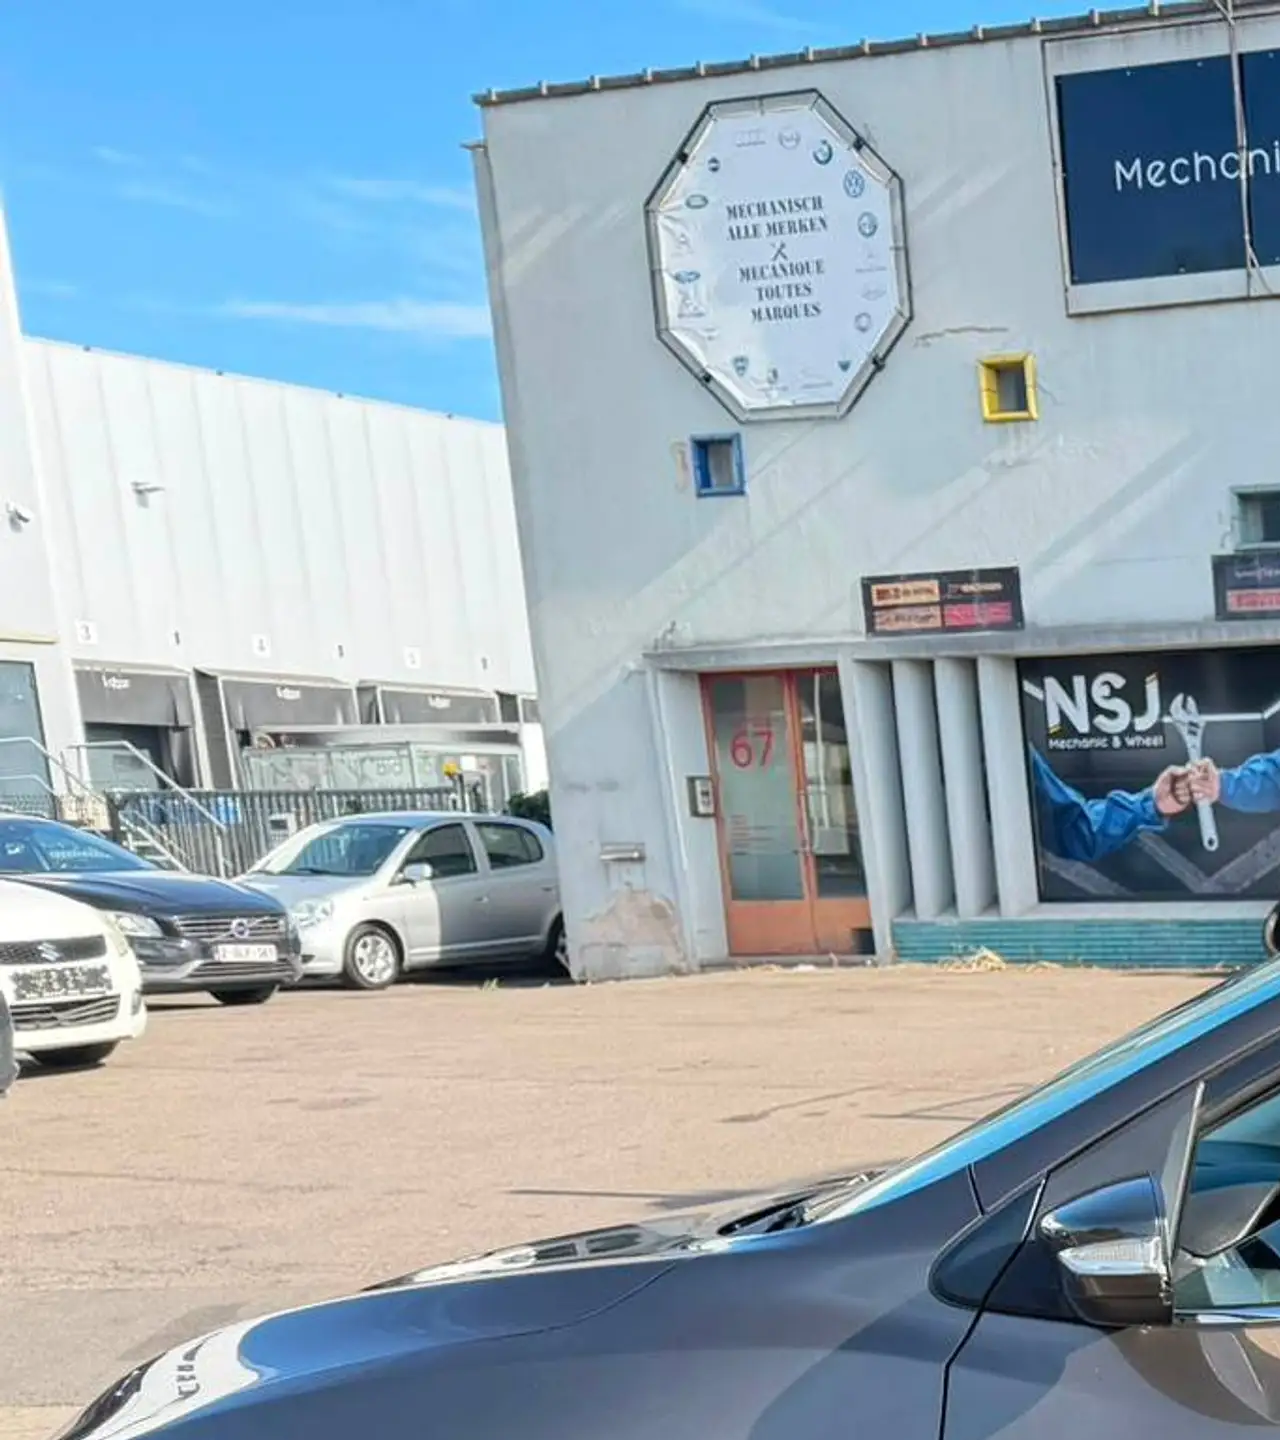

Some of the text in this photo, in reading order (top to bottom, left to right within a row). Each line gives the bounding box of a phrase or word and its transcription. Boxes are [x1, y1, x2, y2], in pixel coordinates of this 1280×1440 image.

[726, 195, 823, 221] MECHANISCH
[726, 215, 829, 241] ALLE MERKEN
[738, 258, 825, 282] MECANIQUE
[757, 283, 812, 302] TOUTES
[751, 302, 822, 323] MARQUES
[1043, 672, 1161, 734] NSJ
[730, 730, 775, 768] 67
[1048, 737, 1109, 750] Mechanic
